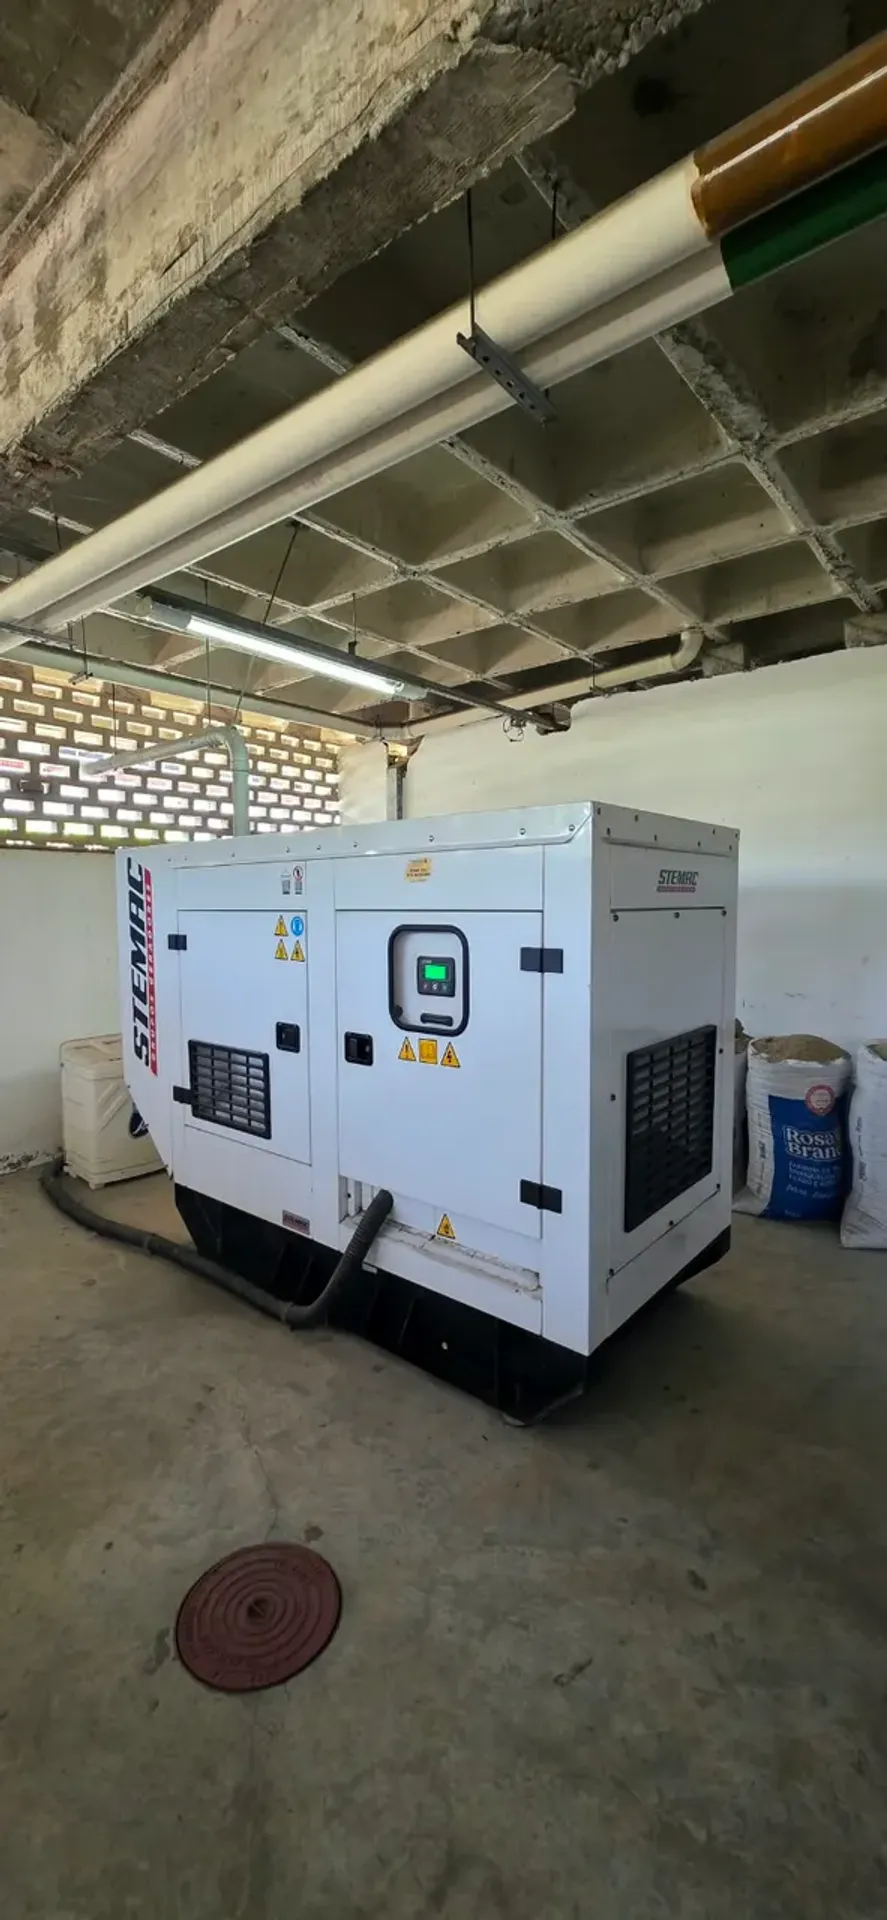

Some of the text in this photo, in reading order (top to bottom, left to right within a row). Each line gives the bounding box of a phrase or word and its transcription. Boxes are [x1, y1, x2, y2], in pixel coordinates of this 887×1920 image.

[658, 869, 699, 886] STEMAC
[127, 857, 150, 1067] STEMAC
[786, 1127, 834, 1146] Rosa
